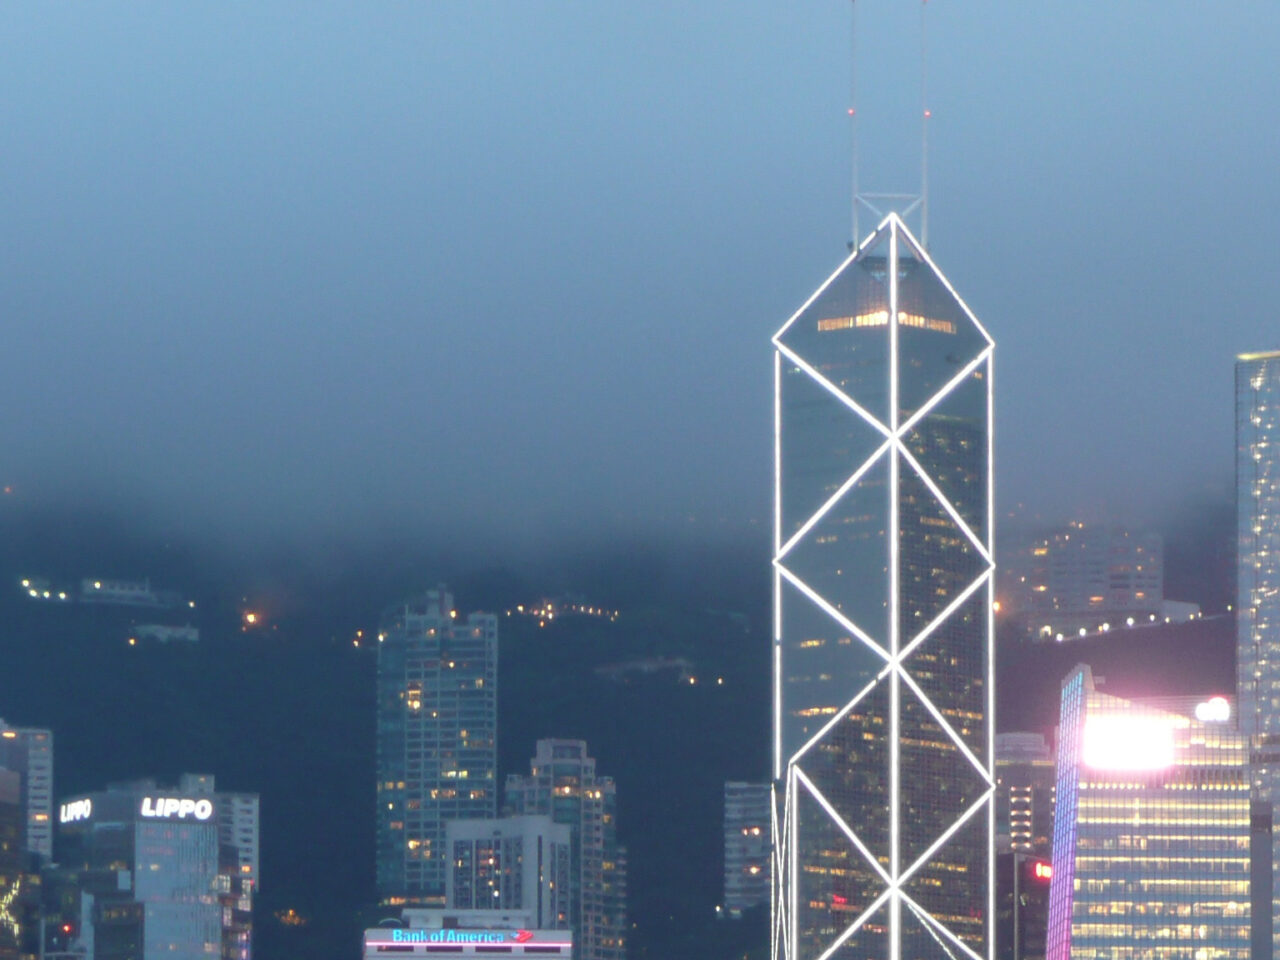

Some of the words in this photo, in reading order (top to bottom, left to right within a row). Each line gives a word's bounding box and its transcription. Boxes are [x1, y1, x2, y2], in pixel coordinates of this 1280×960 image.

[60, 799, 92, 823] LIPPO
[141, 797, 213, 820] LIPPO
[392, 928, 428, 942] Bank
[430, 928, 445, 942] of
[446, 928, 505, 942] America
